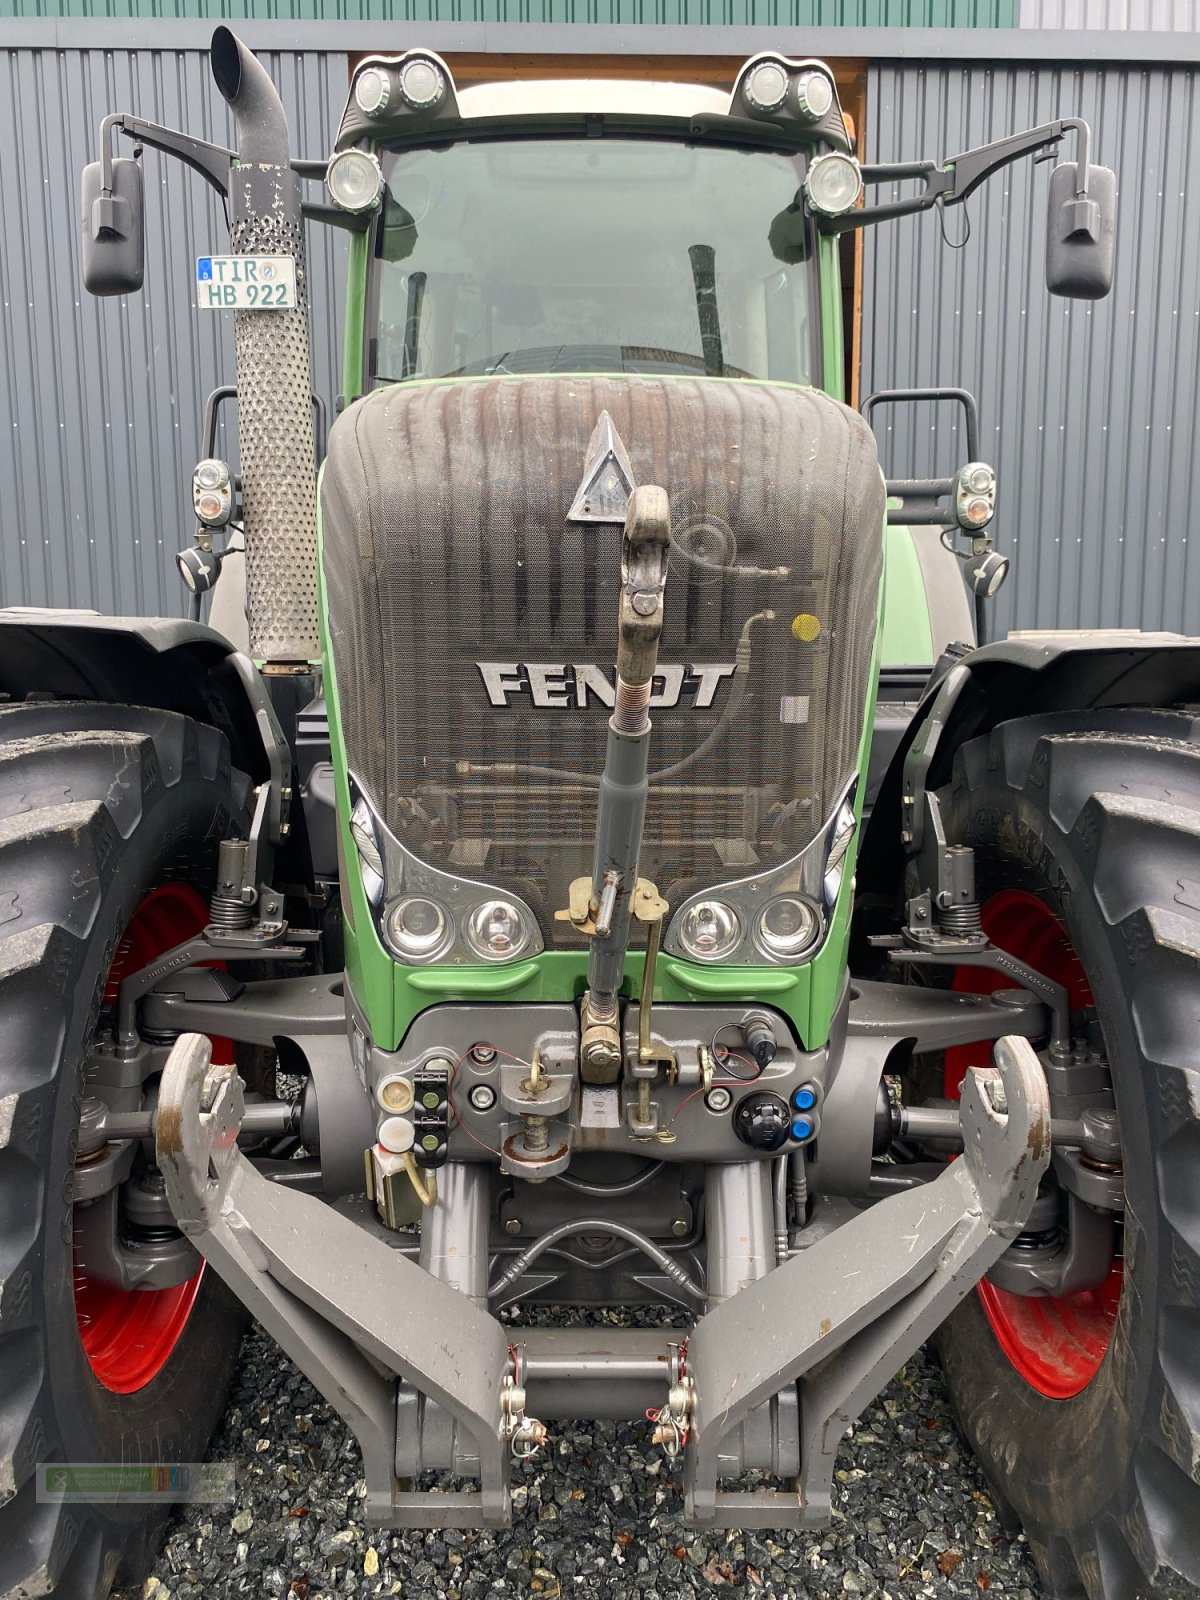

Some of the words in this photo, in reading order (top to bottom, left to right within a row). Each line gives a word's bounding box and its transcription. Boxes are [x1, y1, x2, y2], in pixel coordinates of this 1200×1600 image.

[203, 271, 209, 280] D
[214, 260, 259, 282] TIR
[208, 284, 237, 306] HB
[246, 284, 288, 306] 922
[475, 662, 738, 708] FENDT
